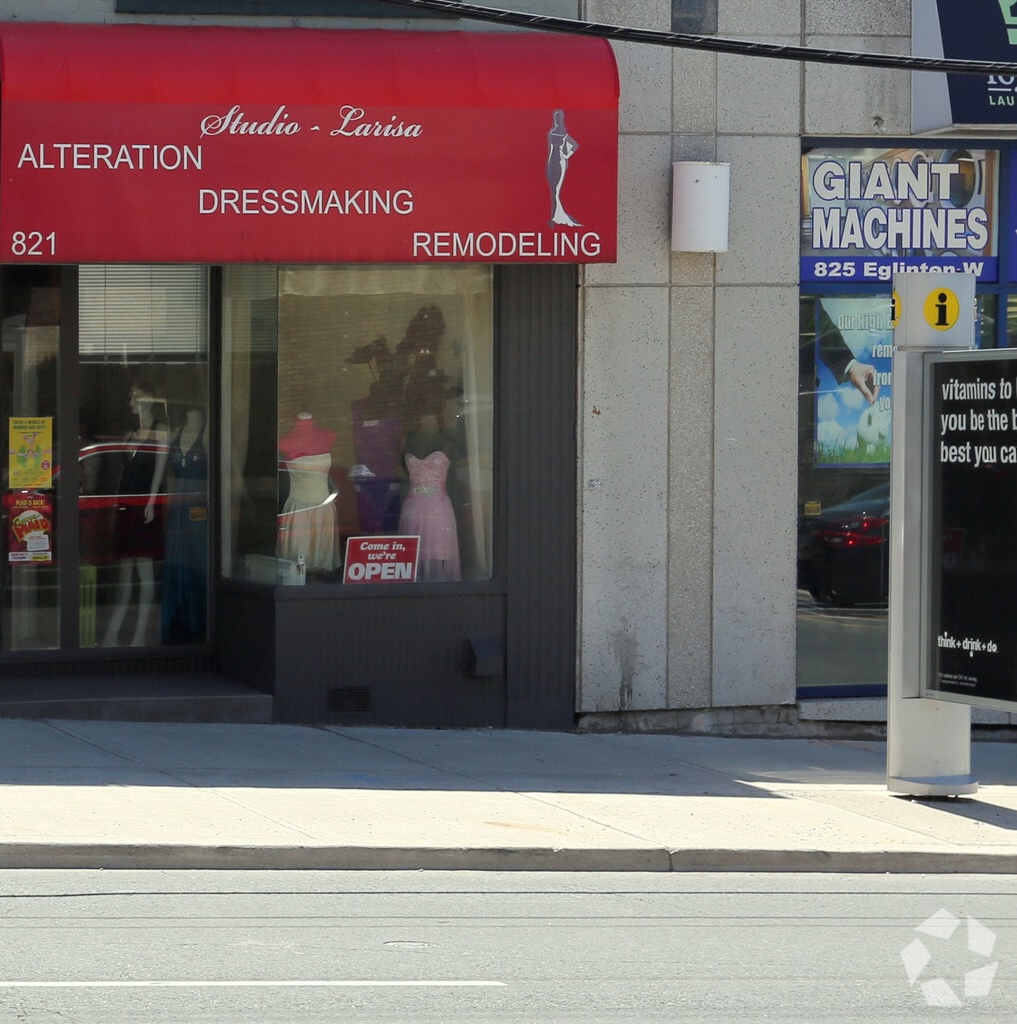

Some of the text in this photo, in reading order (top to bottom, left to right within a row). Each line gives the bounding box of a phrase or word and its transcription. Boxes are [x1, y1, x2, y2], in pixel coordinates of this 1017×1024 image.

[200, 105, 301, 139] Studio
[330, 105, 423, 138] Larisa
[17, 143, 203, 170] ALTERATION
[812, 161, 960, 201] GIANT
[199, 189, 414, 215] DRESSMAKING
[811, 207, 989, 250] MACHINES
[11, 231, 56, 256] 821
[412, 232, 601, 257] REMODELING
[814, 262, 856, 277] 825
[941, 377, 1012, 401] vitamins to
[940, 413, 966, 436] you
[970, 409, 985, 431] be
[987, 408, 1009, 431] the
[940, 441, 971, 463] best
[974, 445, 997, 468] you
[360, 541, 406, 552] Come in,
[368, 551, 396, 560] we're
[348, 562, 413, 581] OPEN
[937, 631, 956, 649] think
[962, 637, 982, 658] drink
